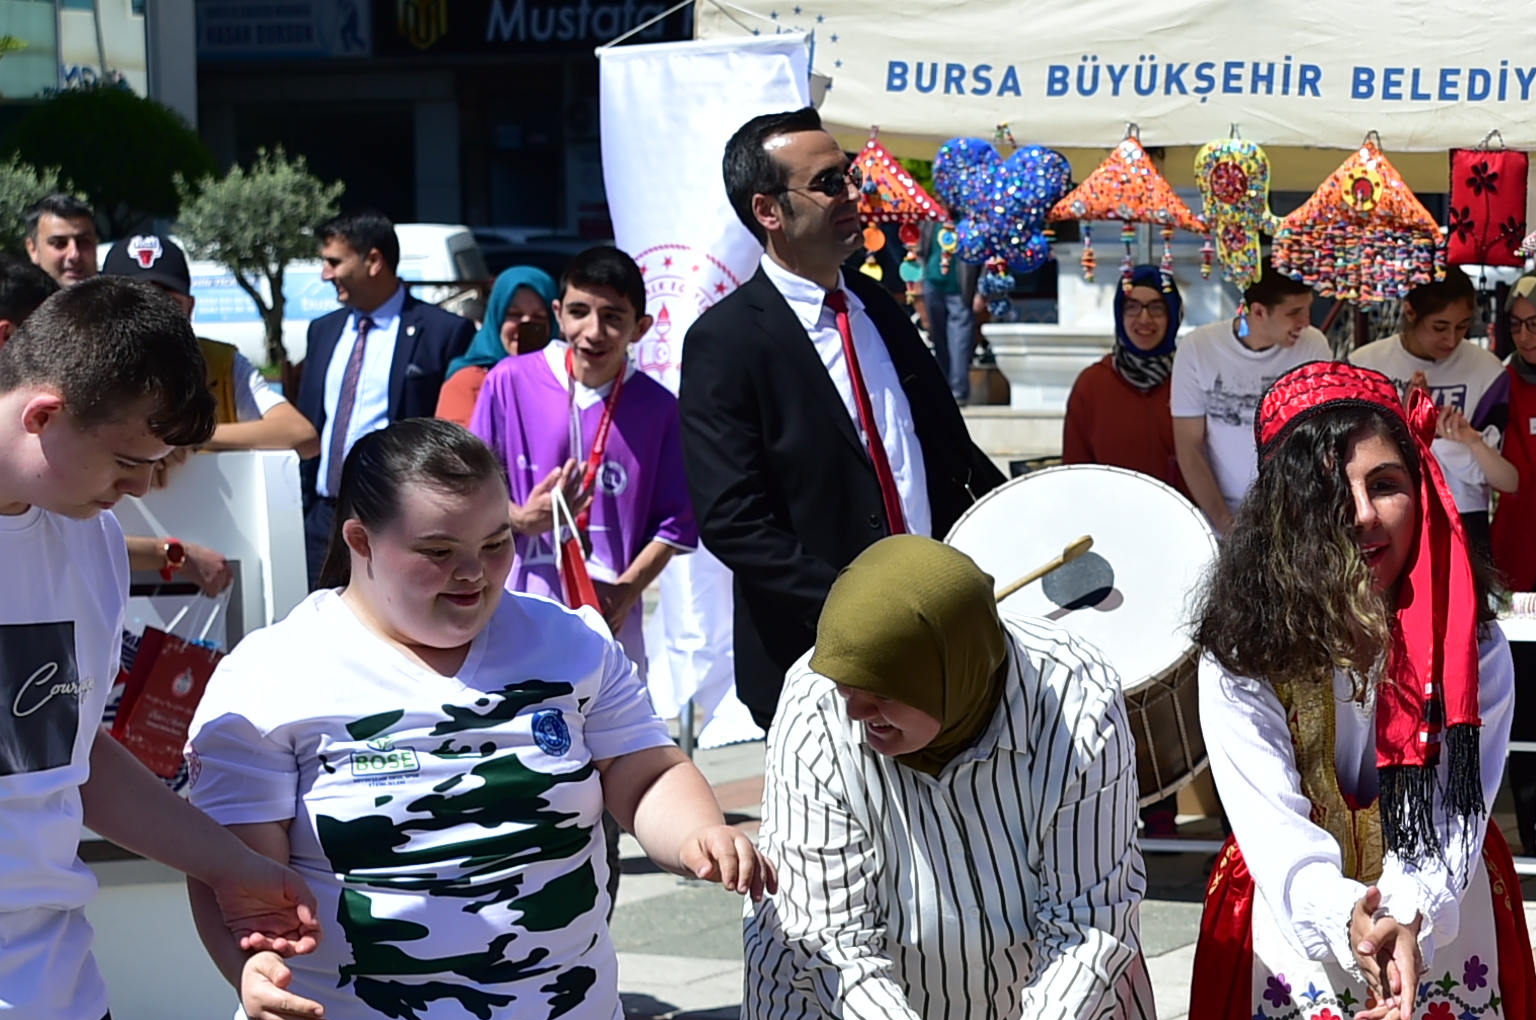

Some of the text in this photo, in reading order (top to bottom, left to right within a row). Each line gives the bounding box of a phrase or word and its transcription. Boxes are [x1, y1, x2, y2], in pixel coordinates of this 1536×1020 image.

[886, 59, 1023, 97] BURSA
[1046, 54, 1323, 103] BÜYÜKŞEHİR
[354, 751, 415, 771] BOSE
